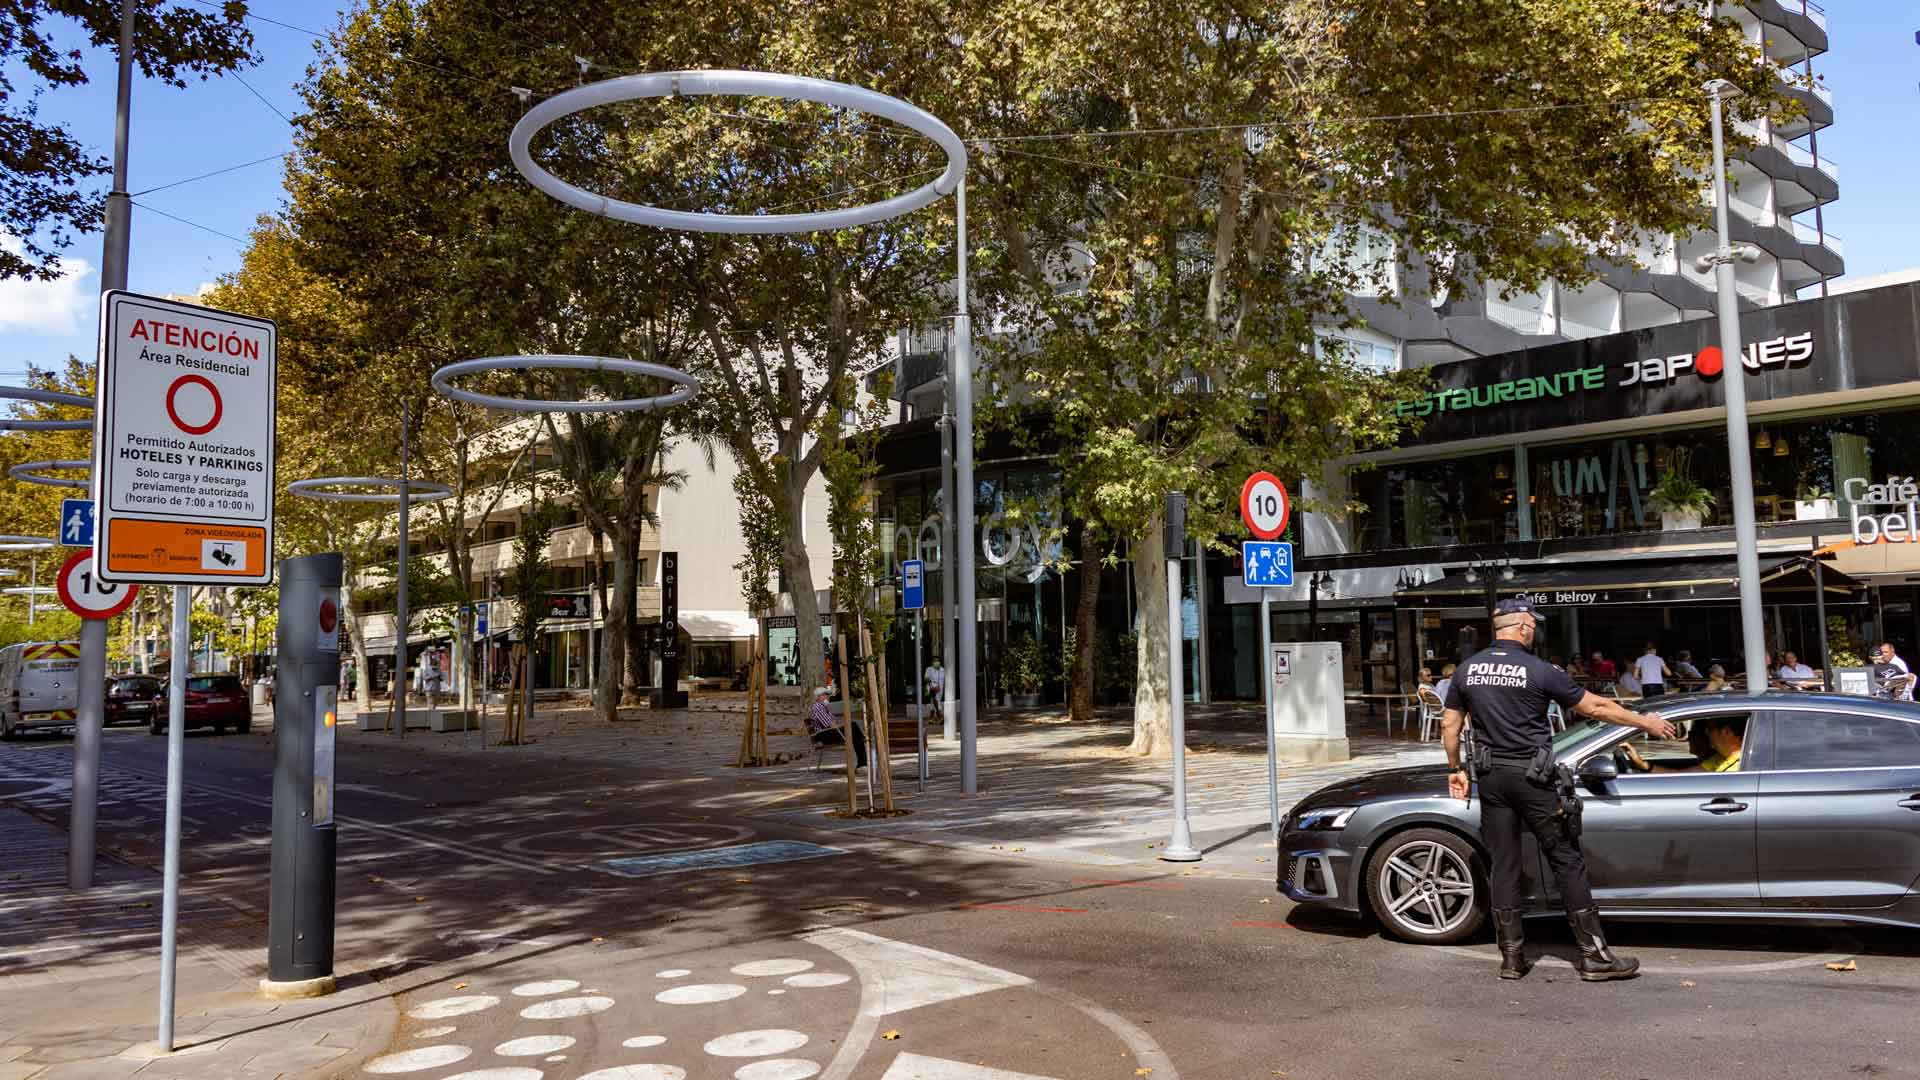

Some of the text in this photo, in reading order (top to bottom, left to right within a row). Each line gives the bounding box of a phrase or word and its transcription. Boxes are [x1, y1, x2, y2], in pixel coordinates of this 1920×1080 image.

[130, 318, 259, 360] ATENCIÓN
[139, 345, 250, 377] Área Residencial
[1396, 364, 1605, 417] ESTAURANTE
[127, 433, 256, 458] Permitido Autorizados
[120, 448, 263, 473] HOTELES Y PARKINGS
[136, 467, 246, 488] Solo carga y descarga
[132, 481, 249, 499] previamente autorizada
[1843, 476, 1918, 505] Café
[125, 493, 255, 512] (horario de 7:00 a 10:00 h)
[1255, 495, 1277, 517] 10
[184, 528, 206, 537] ZONA
[665, 556, 675, 648] belroy
[1555, 591, 1596, 604] belroy
[1466, 676, 1527, 688] BENIDORM
